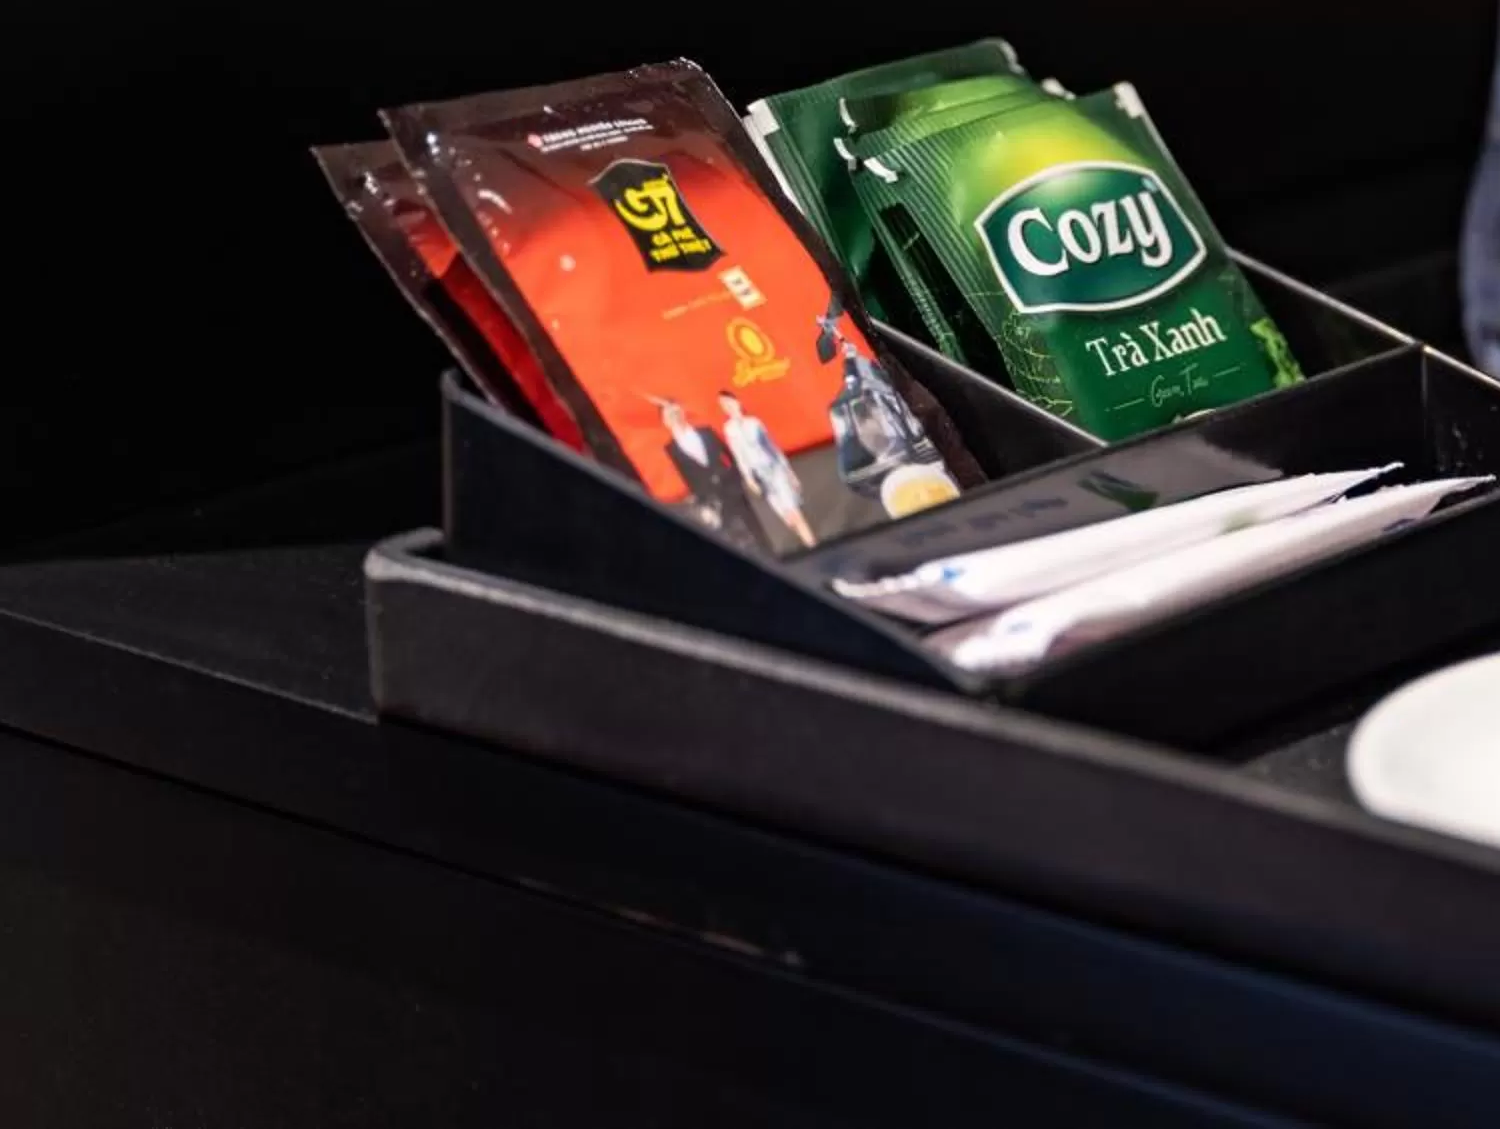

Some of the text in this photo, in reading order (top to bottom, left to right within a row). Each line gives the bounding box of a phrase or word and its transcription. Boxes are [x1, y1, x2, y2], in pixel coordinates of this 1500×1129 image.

[1007, 190, 1173, 276] Cozy
[1084, 306, 1228, 377] Trà Xanh
